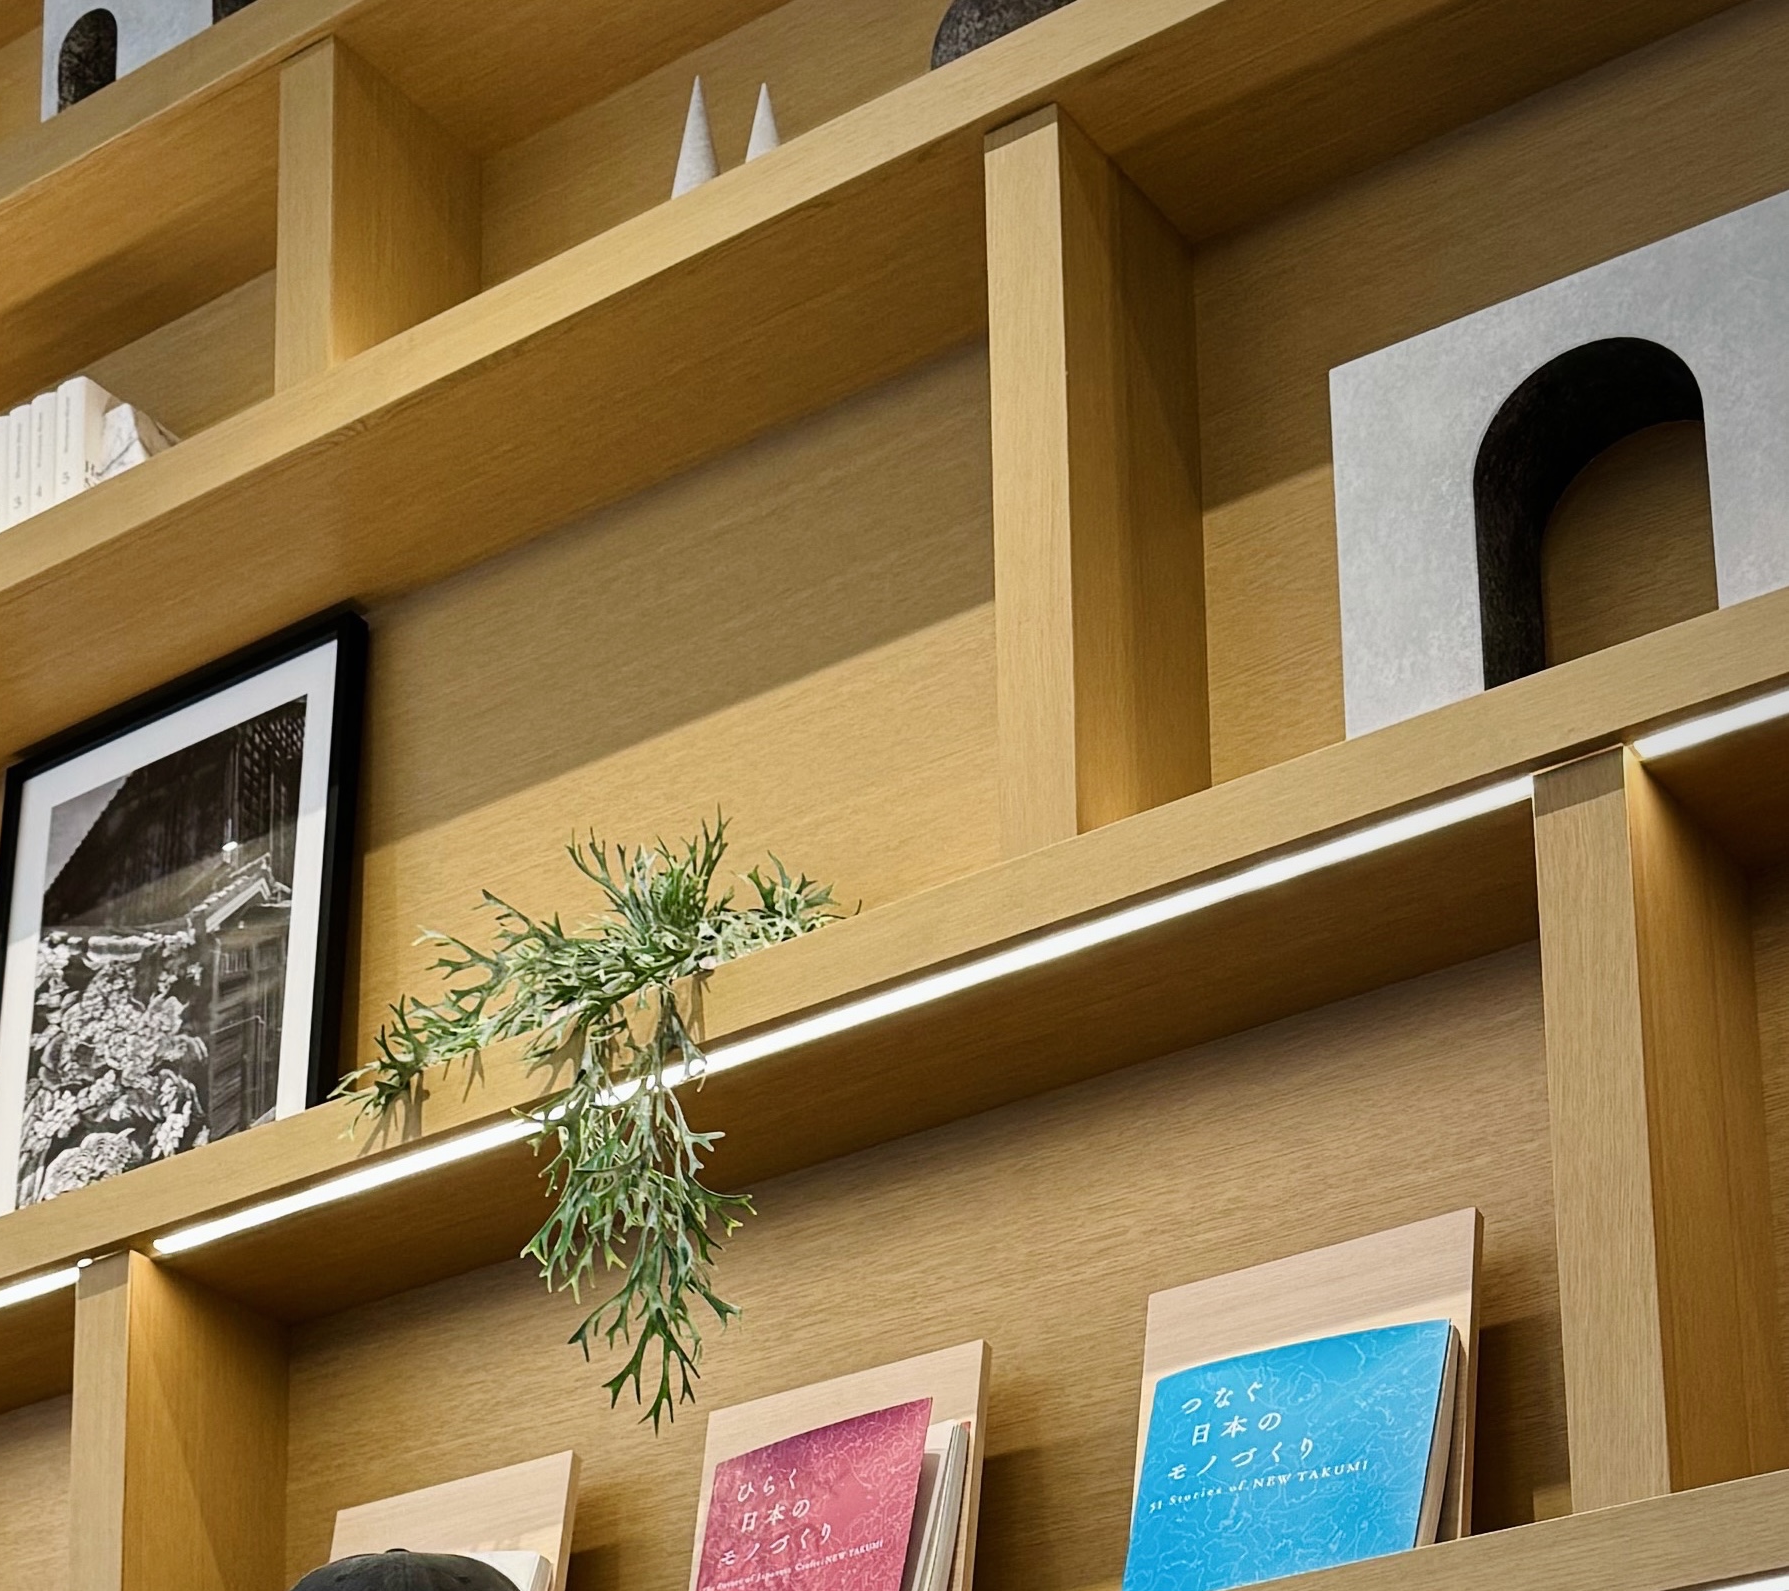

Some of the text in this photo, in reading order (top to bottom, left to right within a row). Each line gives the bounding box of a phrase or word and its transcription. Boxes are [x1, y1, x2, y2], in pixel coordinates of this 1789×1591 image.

[1180, 1381, 1263, 1416] つなぐ
[1191, 1412, 1283, 1446] 日本の
[1167, 1437, 1316, 1481] モノづくり
[737, 1468, 798, 1502] ひらく
[1168, 1487, 1222, 1506] Stories
[1228, 1481, 1246, 1493] of
[1252, 1472, 1293, 1490] NEW
[1297, 1459, 1369, 1482] TAKUMI
[740, 1498, 811, 1533] 日本の
[717, 1522, 833, 1569] モノづくり
[824, 1551, 847, 1566] NEW
[848, 1539, 884, 1558] TAKUMI
